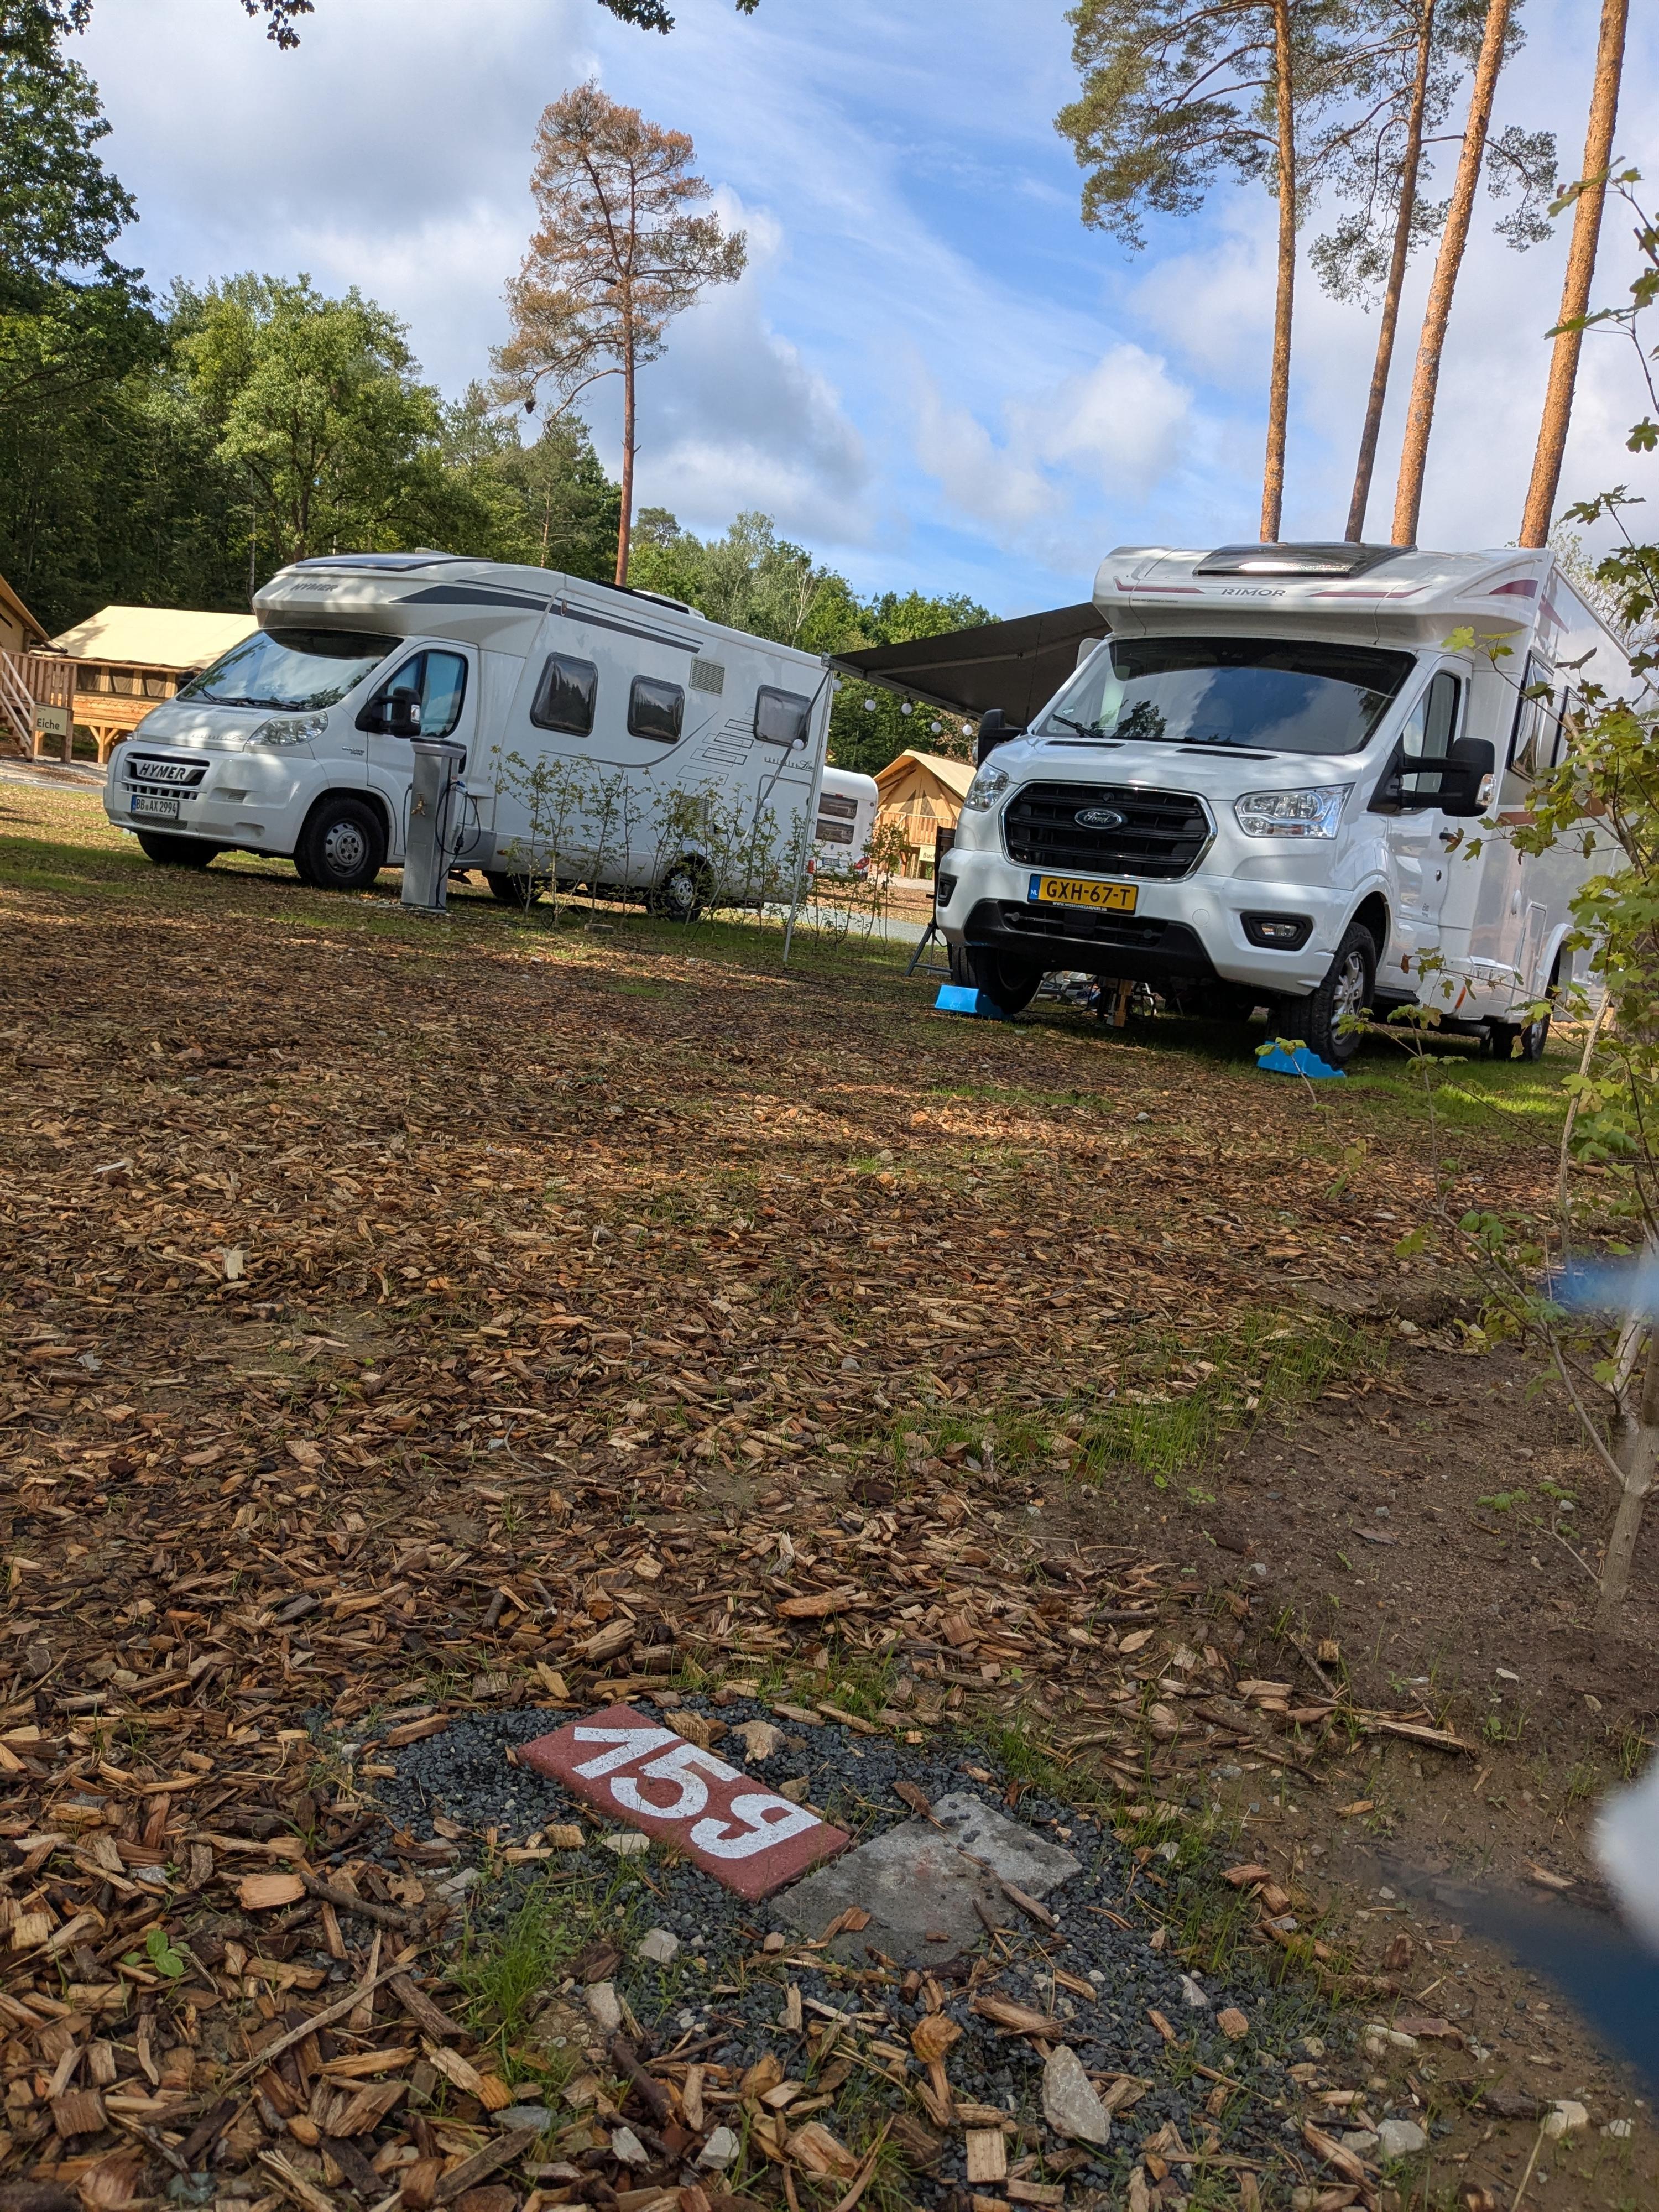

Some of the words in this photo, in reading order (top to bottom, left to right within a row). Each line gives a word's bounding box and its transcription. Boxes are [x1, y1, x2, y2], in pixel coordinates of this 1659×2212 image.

[290, 583, 338, 592] HYMER
[36, 718, 60, 730] Eiche
[139, 763, 186, 780] HYMER
[136, 799, 145, 810] BB
[149, 800, 158, 811] AX
[159, 801, 176, 813] 2994
[1084, 811, 1110, 823] Ford
[1046, 880, 1131, 906] GXH-67-T
[572, 1726, 822, 1859] 159
